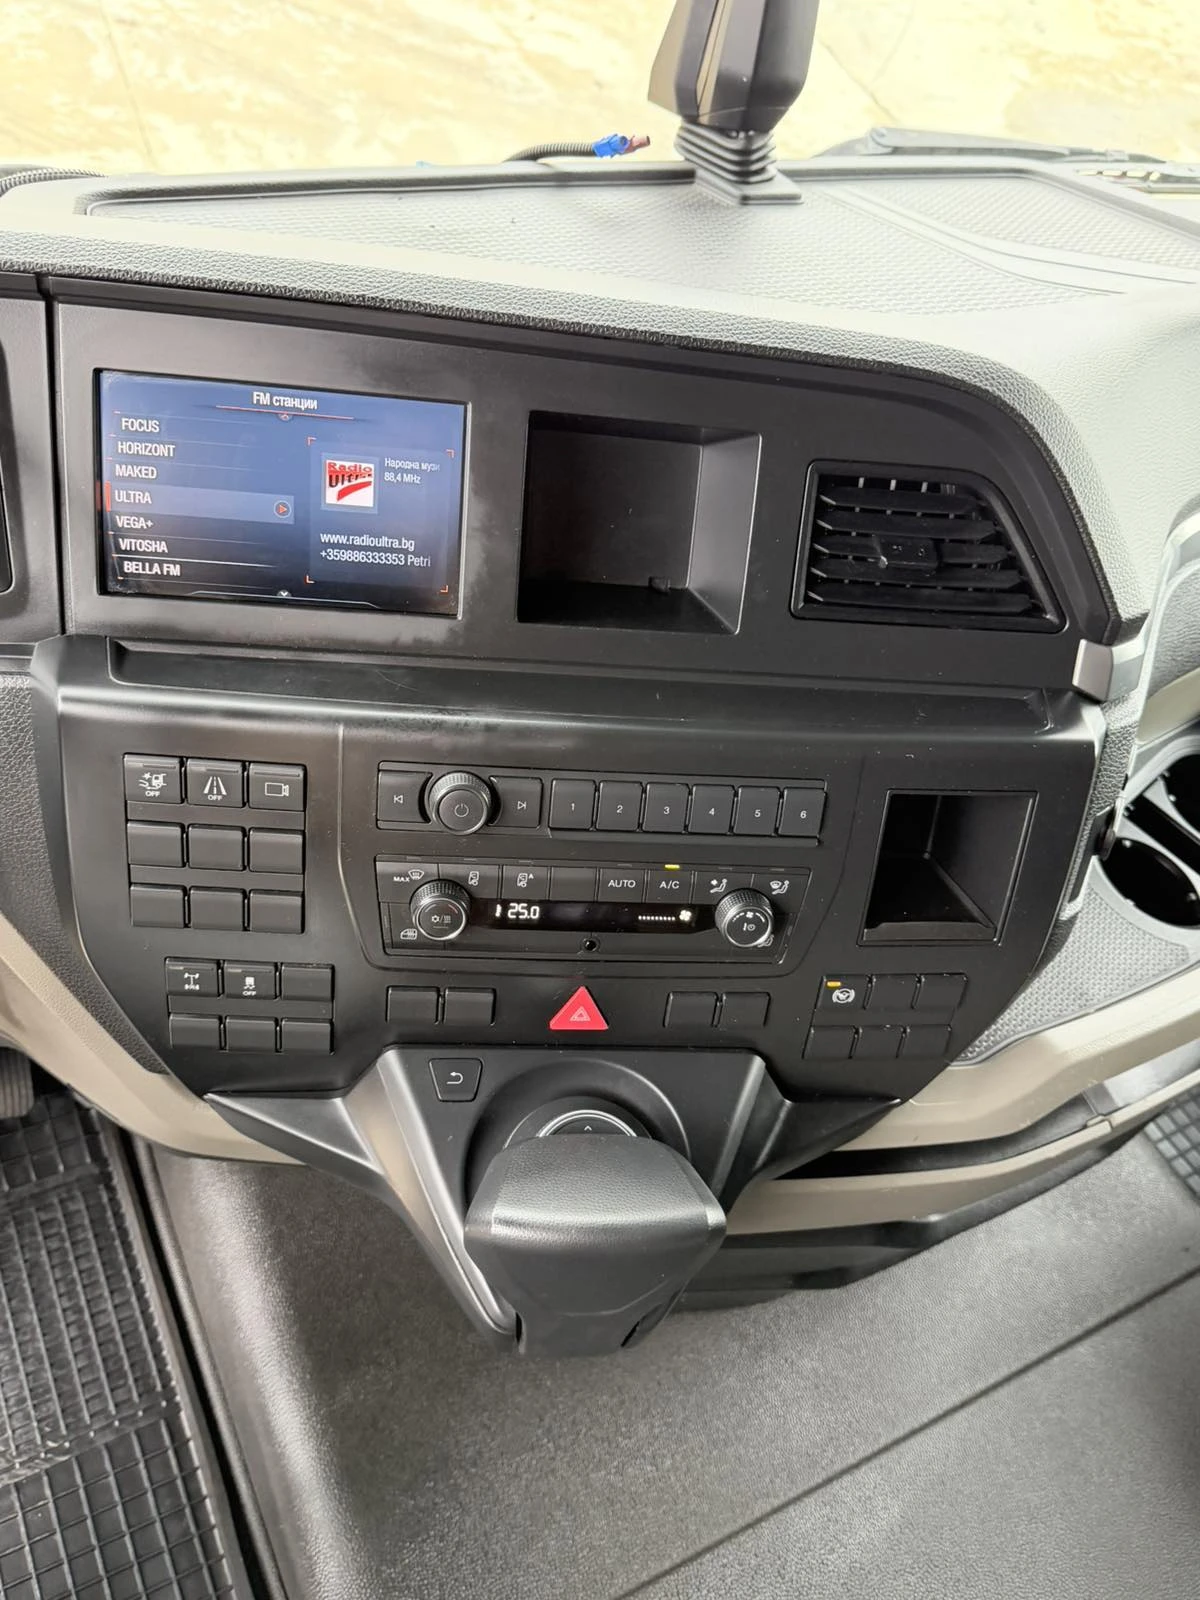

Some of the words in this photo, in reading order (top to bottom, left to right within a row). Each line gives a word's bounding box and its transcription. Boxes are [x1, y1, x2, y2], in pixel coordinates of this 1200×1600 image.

[252, 391, 271, 405] FM
[273, 395, 318, 411] станции
[121, 417, 160, 433] FOCUS
[117, 441, 176, 457] HORIZONT
[328, 461, 373, 473] Radio
[384, 457, 420, 470] Народна
[115, 464, 157, 480] MAKED
[384, 471, 402, 483] 88,4
[402, 472, 421, 485] MHz
[114, 489, 152, 504] ULTRA
[115, 515, 154, 530] VEGA+
[118, 538, 169, 553] VITOSHA
[319, 533, 415, 552] www.radioultra.bg
[319, 548, 405, 566] +359886333353
[407, 554, 431, 567] Petri
[123, 561, 161, 576] BELLA
[163, 563, 181, 577] FM
[570, 803, 575, 811] 1
[616, 805, 623, 813] 2
[663, 806, 670, 815] 3
[708, 808, 715, 816] 4
[754, 809, 761, 818] 5
[800, 810, 807, 819] 6
[393, 875, 410, 883] MAX
[607, 879, 636, 889] AUTO
[659, 880, 680, 889] A/C
[507, 902, 540, 919] 25.0
